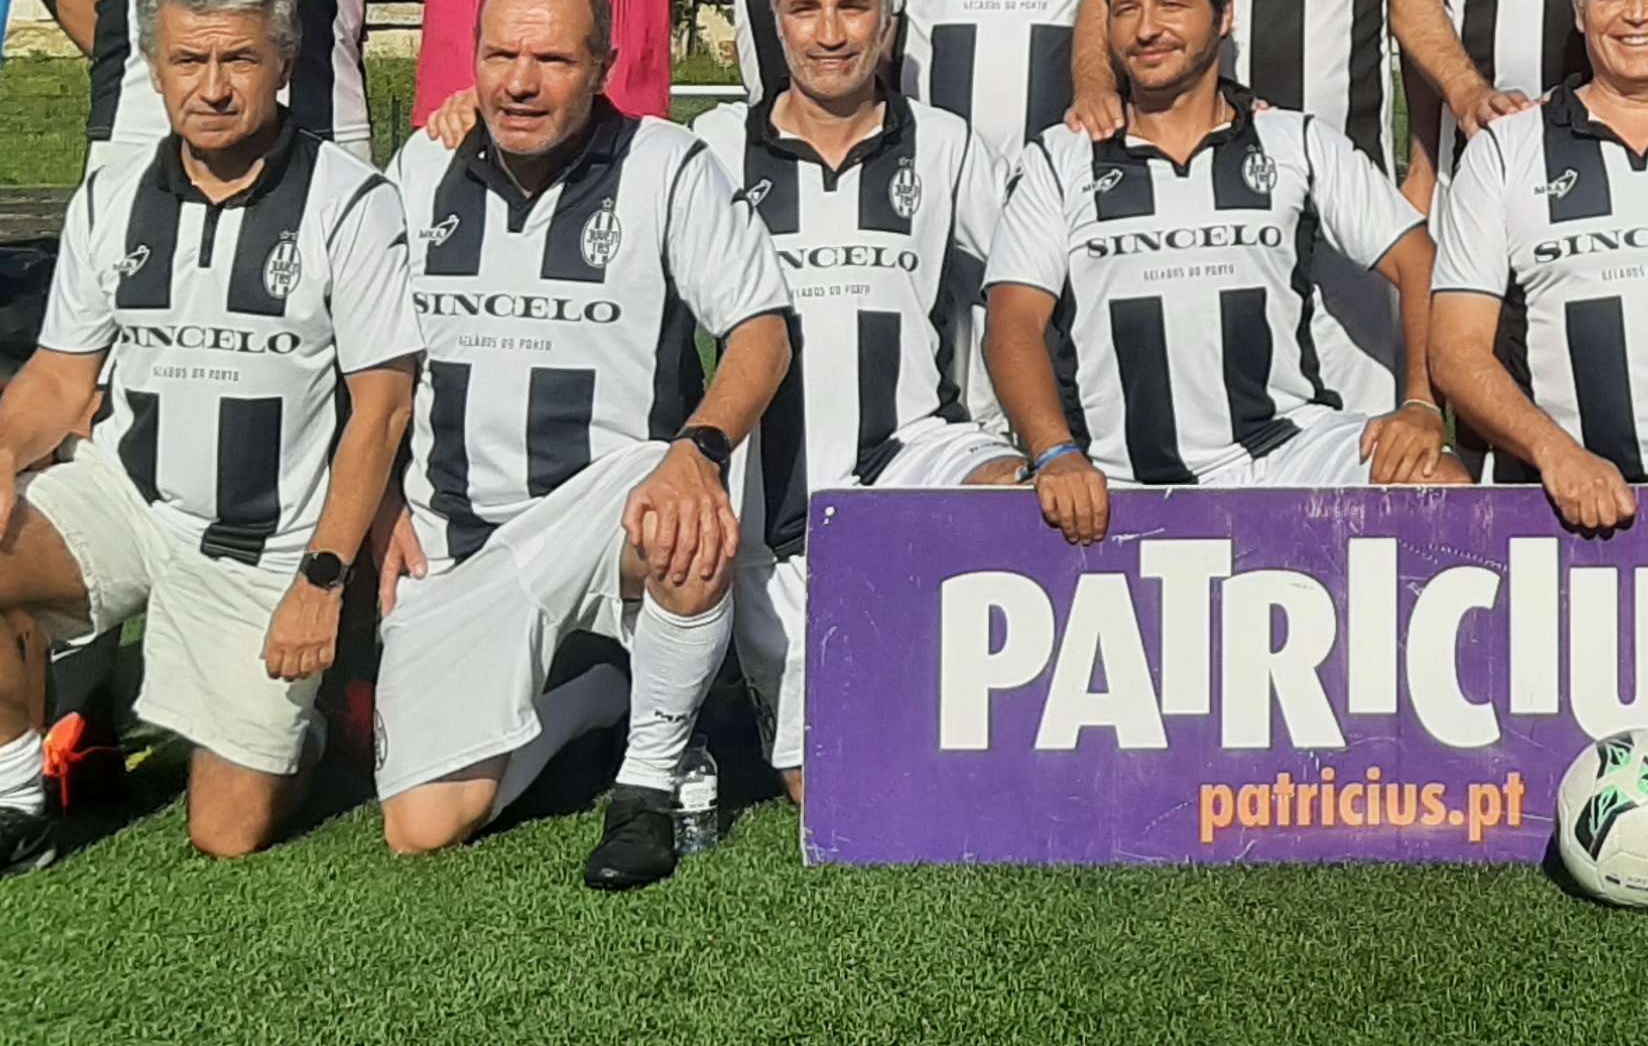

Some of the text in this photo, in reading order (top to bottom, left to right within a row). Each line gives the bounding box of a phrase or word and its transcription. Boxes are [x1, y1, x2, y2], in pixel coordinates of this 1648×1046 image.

[1086, 225, 1282, 258] SINCELO
[776, 245, 919, 272] NCELO
[412, 292, 621, 324] SINCELO
[791, 287, 824, 298] LADOS
[1199, 770, 1524, 841] patricius.pt
